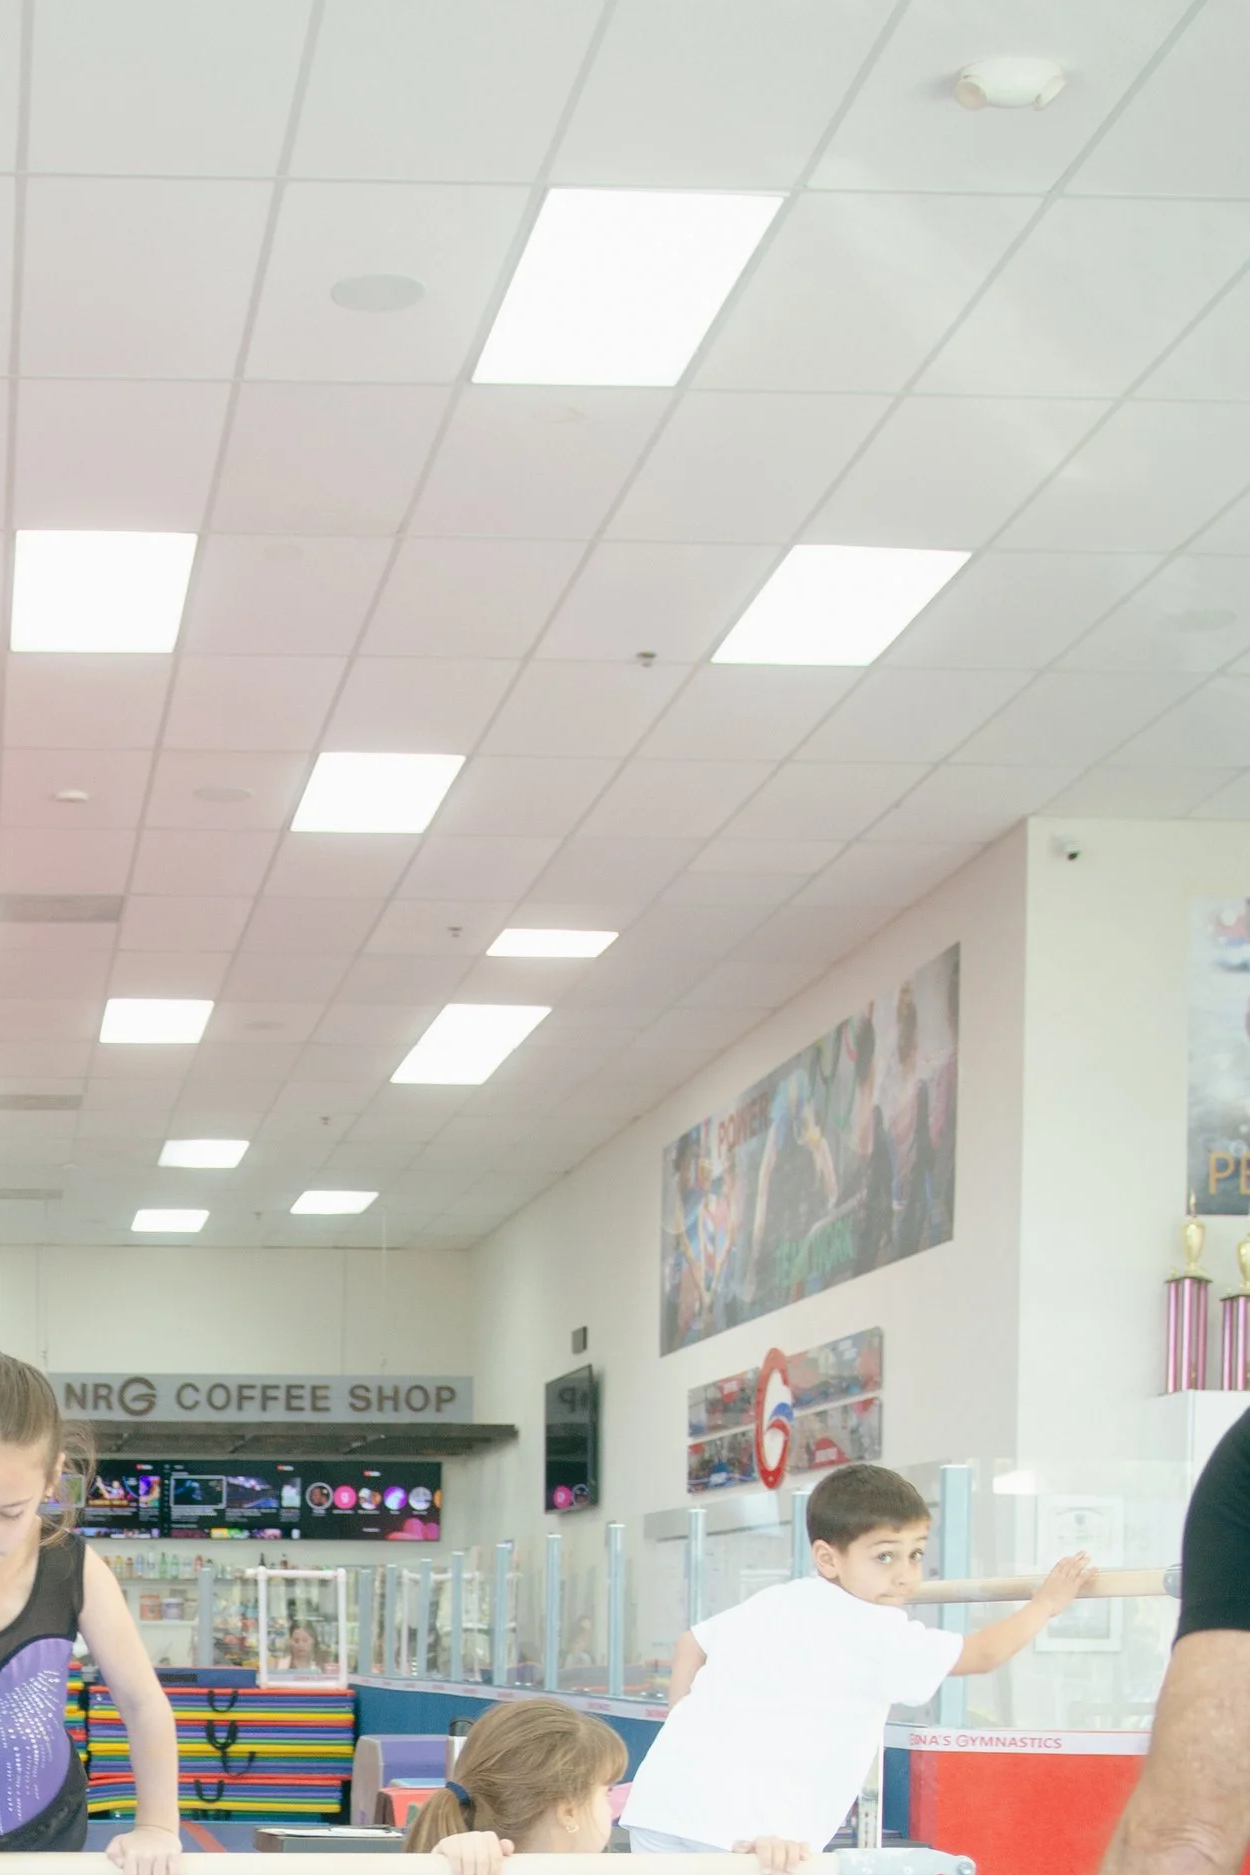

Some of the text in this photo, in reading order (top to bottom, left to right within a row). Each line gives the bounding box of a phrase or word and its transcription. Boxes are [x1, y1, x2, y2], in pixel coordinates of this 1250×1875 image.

[64, 1376, 456, 1416] NRG COFFEE SHOP
[955, 1734, 1062, 1749] GYMNASTICS
